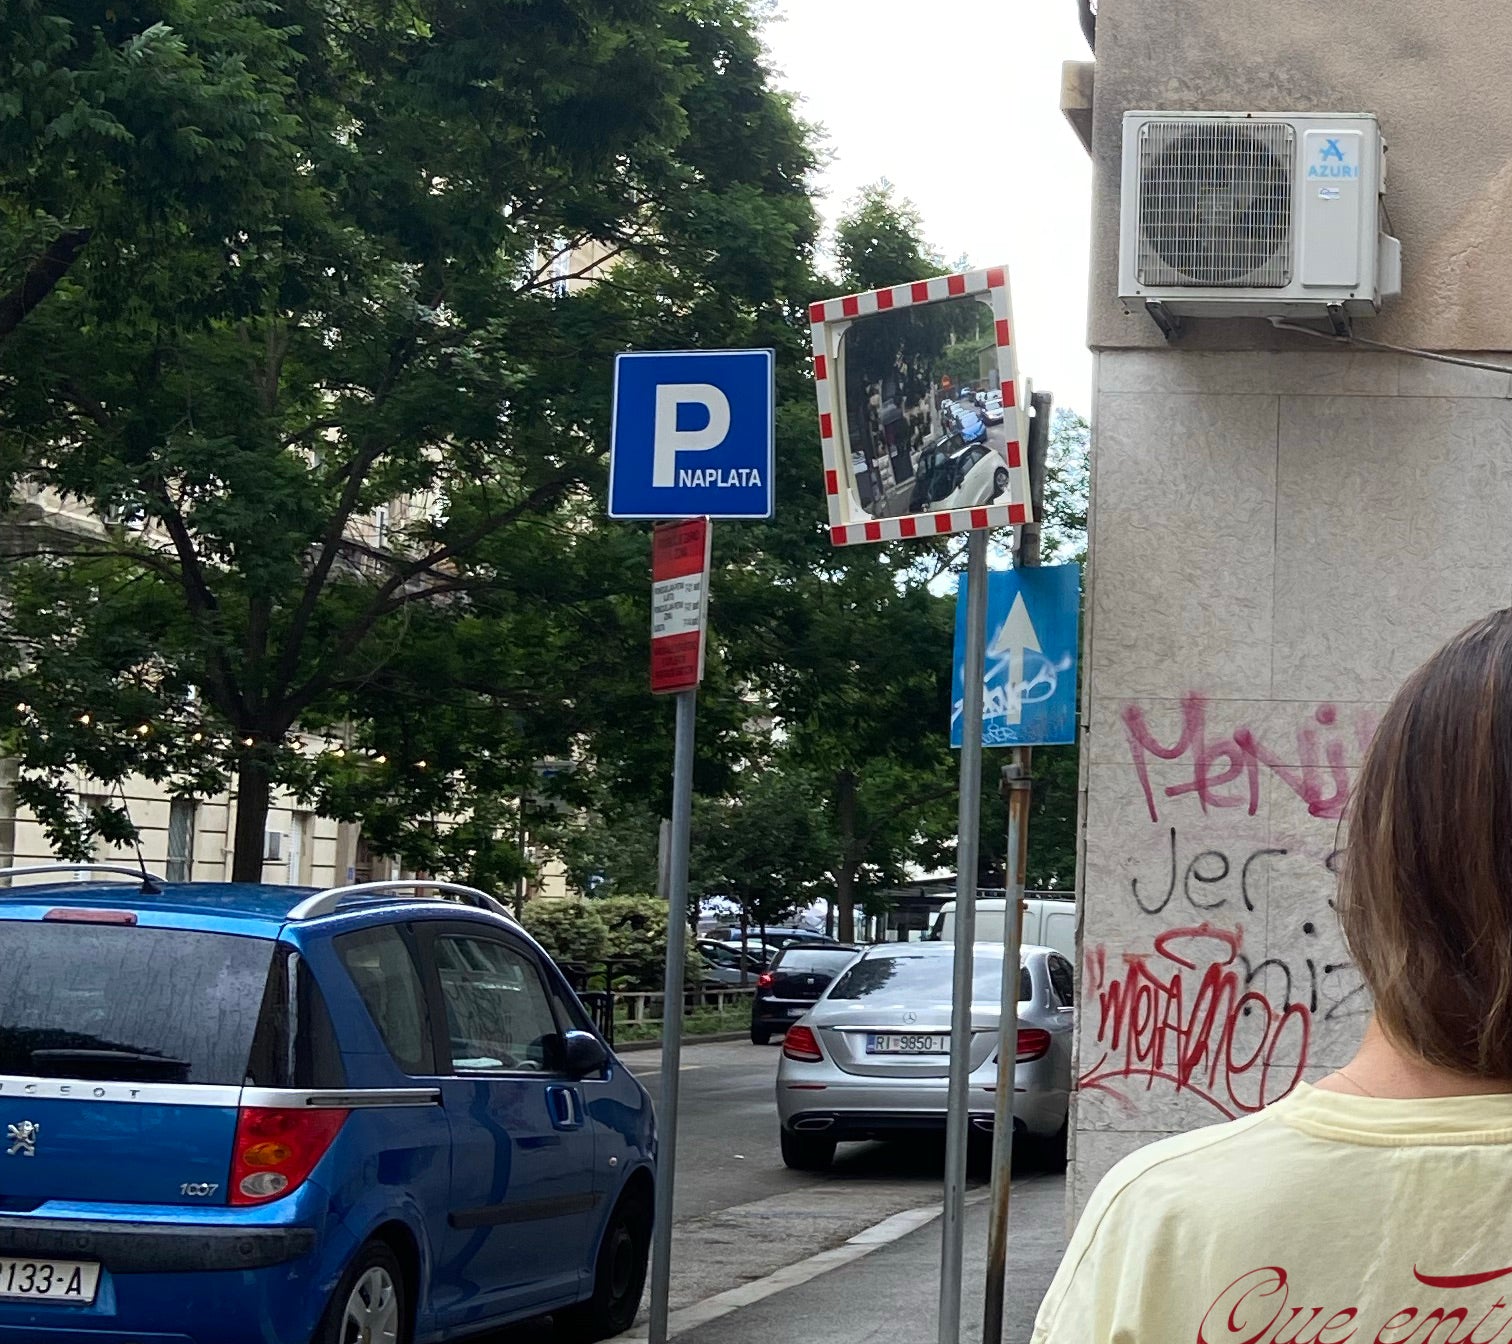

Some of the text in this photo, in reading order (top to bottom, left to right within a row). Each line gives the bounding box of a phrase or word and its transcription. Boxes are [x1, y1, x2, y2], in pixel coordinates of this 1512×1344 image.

[1308, 165, 1359, 177] AZURI
[652, 383, 731, 488] P
[679, 468, 762, 488] NAPLATA
[876, 1036, 891, 1050] RI
[0, 1082, 141, 1100] GEOT
[180, 1181, 220, 1198] 1007
[0, 1261, 81, 1296] 133-A
